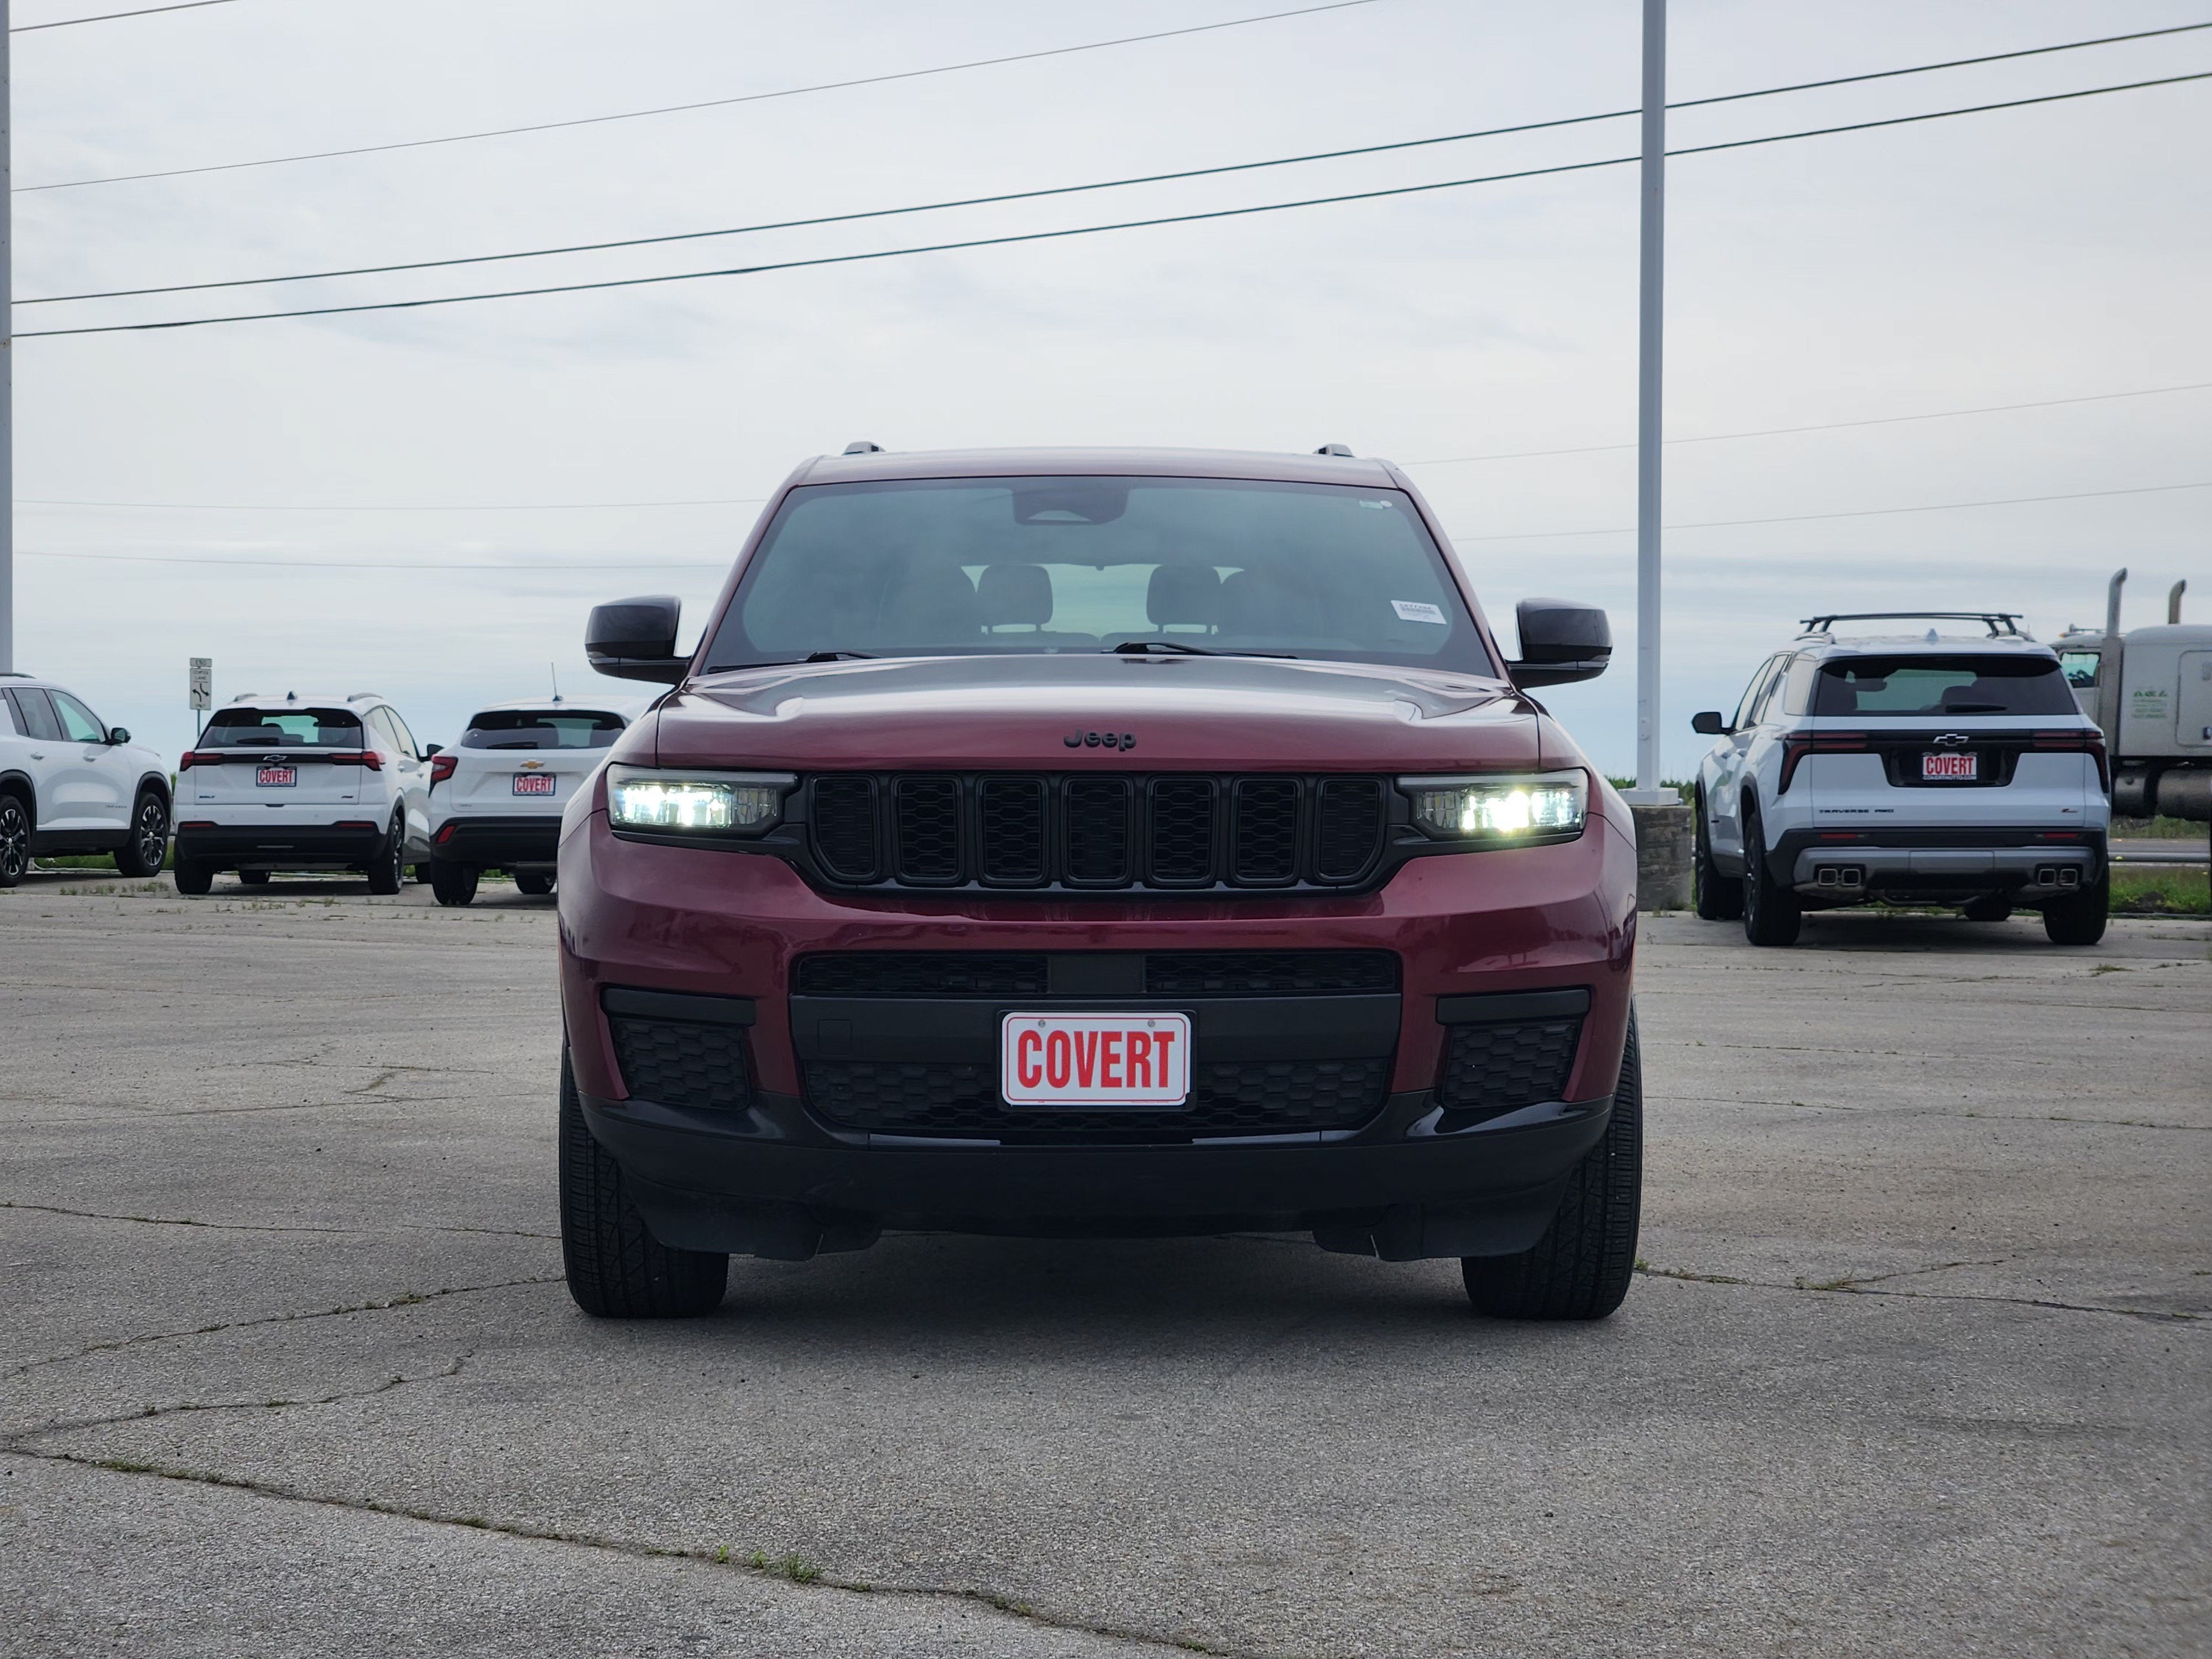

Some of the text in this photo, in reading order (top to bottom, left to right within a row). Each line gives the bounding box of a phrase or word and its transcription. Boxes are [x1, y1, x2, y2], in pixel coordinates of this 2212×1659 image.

[1063, 728, 1136, 752] Jeep
[1926, 757, 1974, 775] COVERT
[259, 770, 293, 782] COVERT
[517, 778, 552, 792] COVERT
[1018, 1030, 1175, 1088] COVERT
